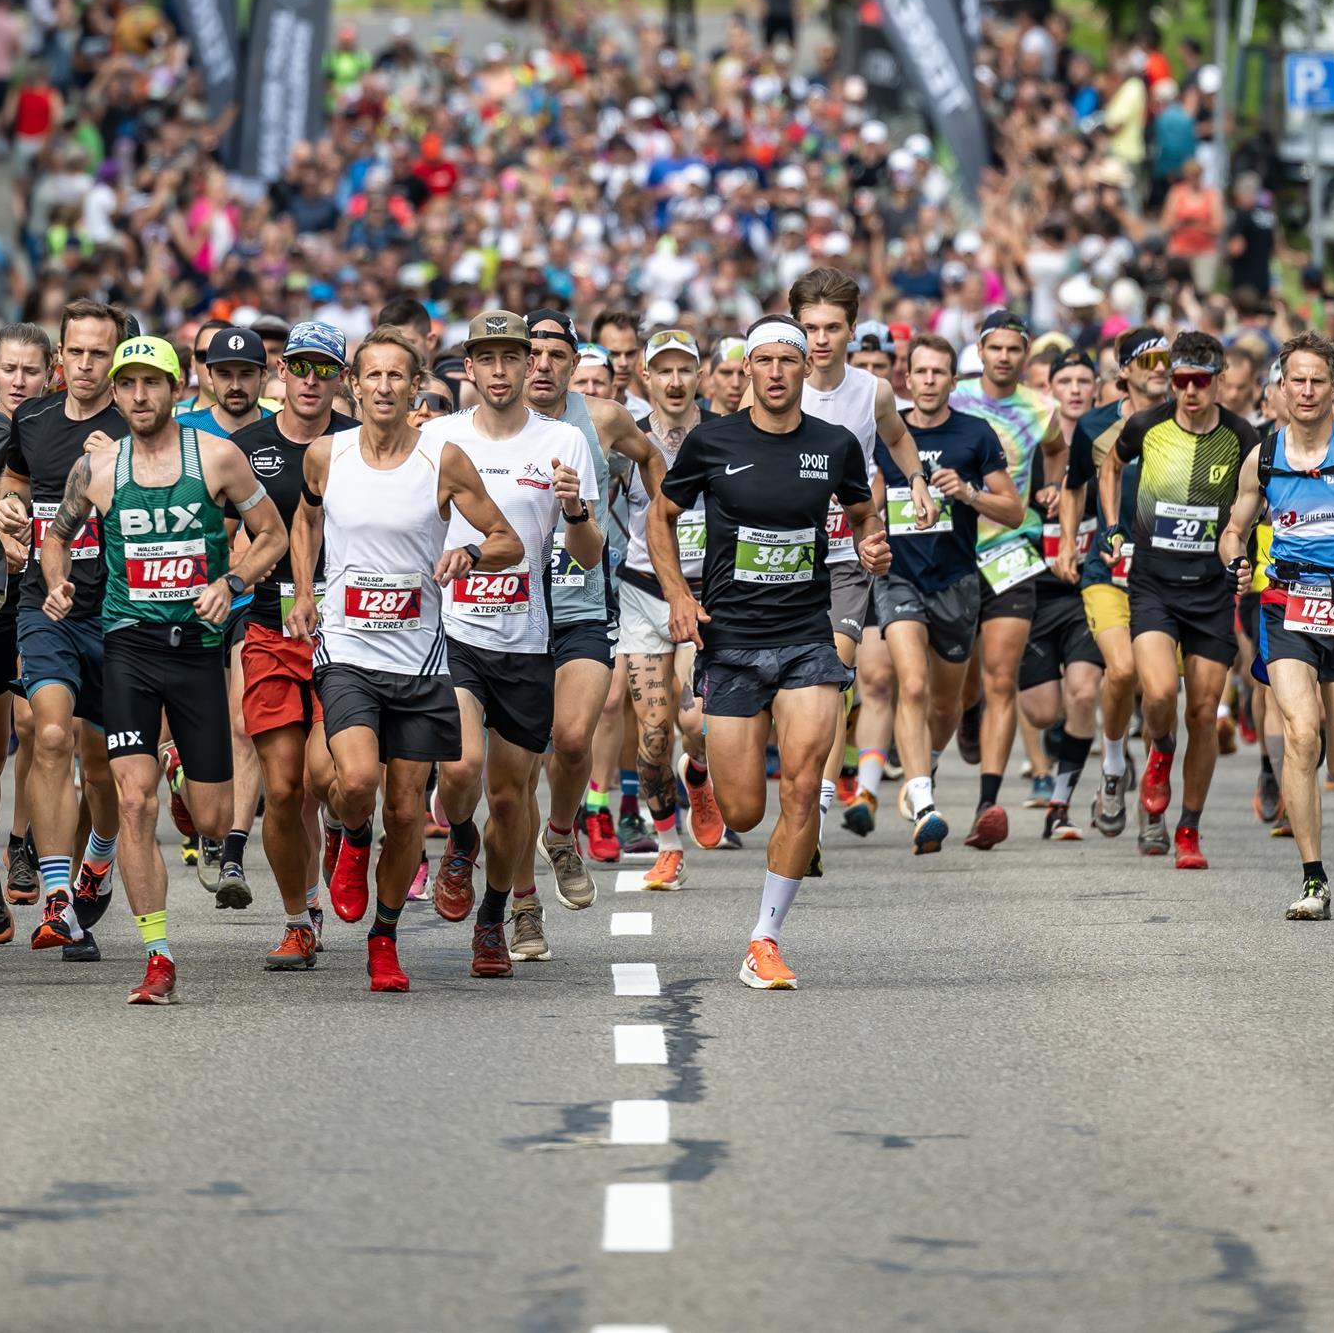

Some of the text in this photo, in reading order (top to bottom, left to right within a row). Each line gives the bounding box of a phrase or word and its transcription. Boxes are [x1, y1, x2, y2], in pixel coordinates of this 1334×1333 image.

[1295, 59, 1327, 107] P
[122, 344, 155, 358] BIX
[799, 453, 829, 471] SPORT
[119, 502, 203, 536] BIX
[677, 526, 704, 544] 27
[751, 531, 778, 540] WALSER
[1172, 519, 1200, 537] 20
[680, 550, 703, 558] ERREX
[753, 546, 801, 566] 384
[142, 558, 194, 581] 1140
[764, 573, 796, 582] TERREX
[353, 580, 397, 588] TRAILCHALLENGE
[464, 576, 520, 597] 1240
[158, 589, 191, 599] TERREX
[358, 590, 412, 612] 1287
[476, 596, 506, 605] Christoph
[369, 611, 399, 620] Wolfgang
[481, 605, 512, 613] TERREX
[372, 621, 405, 629] TERREX
[107, 731, 144, 750] BIX
